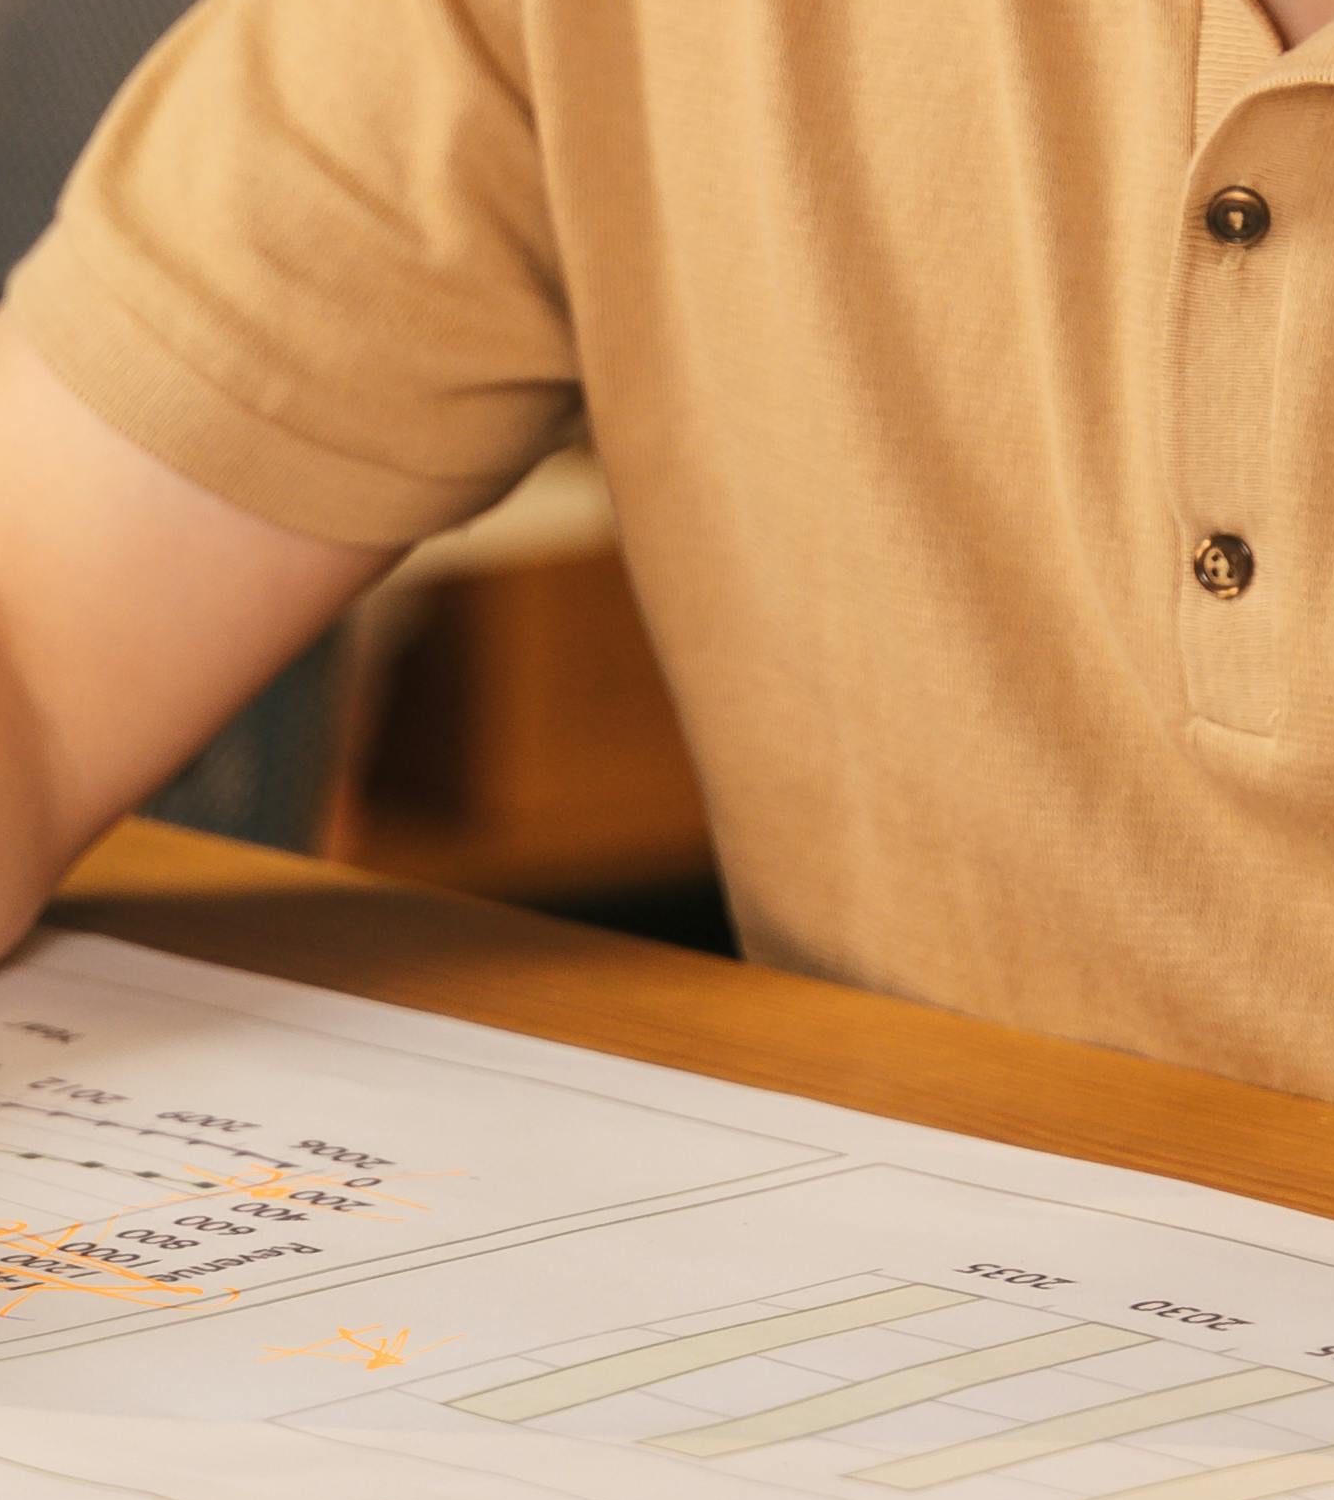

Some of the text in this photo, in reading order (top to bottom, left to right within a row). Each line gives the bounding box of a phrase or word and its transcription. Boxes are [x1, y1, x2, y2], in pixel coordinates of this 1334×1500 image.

[26, 1075, 132, 1105] 2012
[155, 1109, 261, 1133] 2009
[287, 1137, 396, 1169] 2006
[341, 1175, 382, 1188] 0
[228, 1200, 308, 1222] 400
[286, 1188, 374, 1212] 200
[172, 1213, 256, 1236] 600
[114, 1227, 200, 1250] 800
[53, 1239, 161, 1267] 1000
[140, 1240, 322, 1285] Revenue
[950, 1258, 1076, 1292] 2035
[1127, 1296, 1253, 1333] 2030
